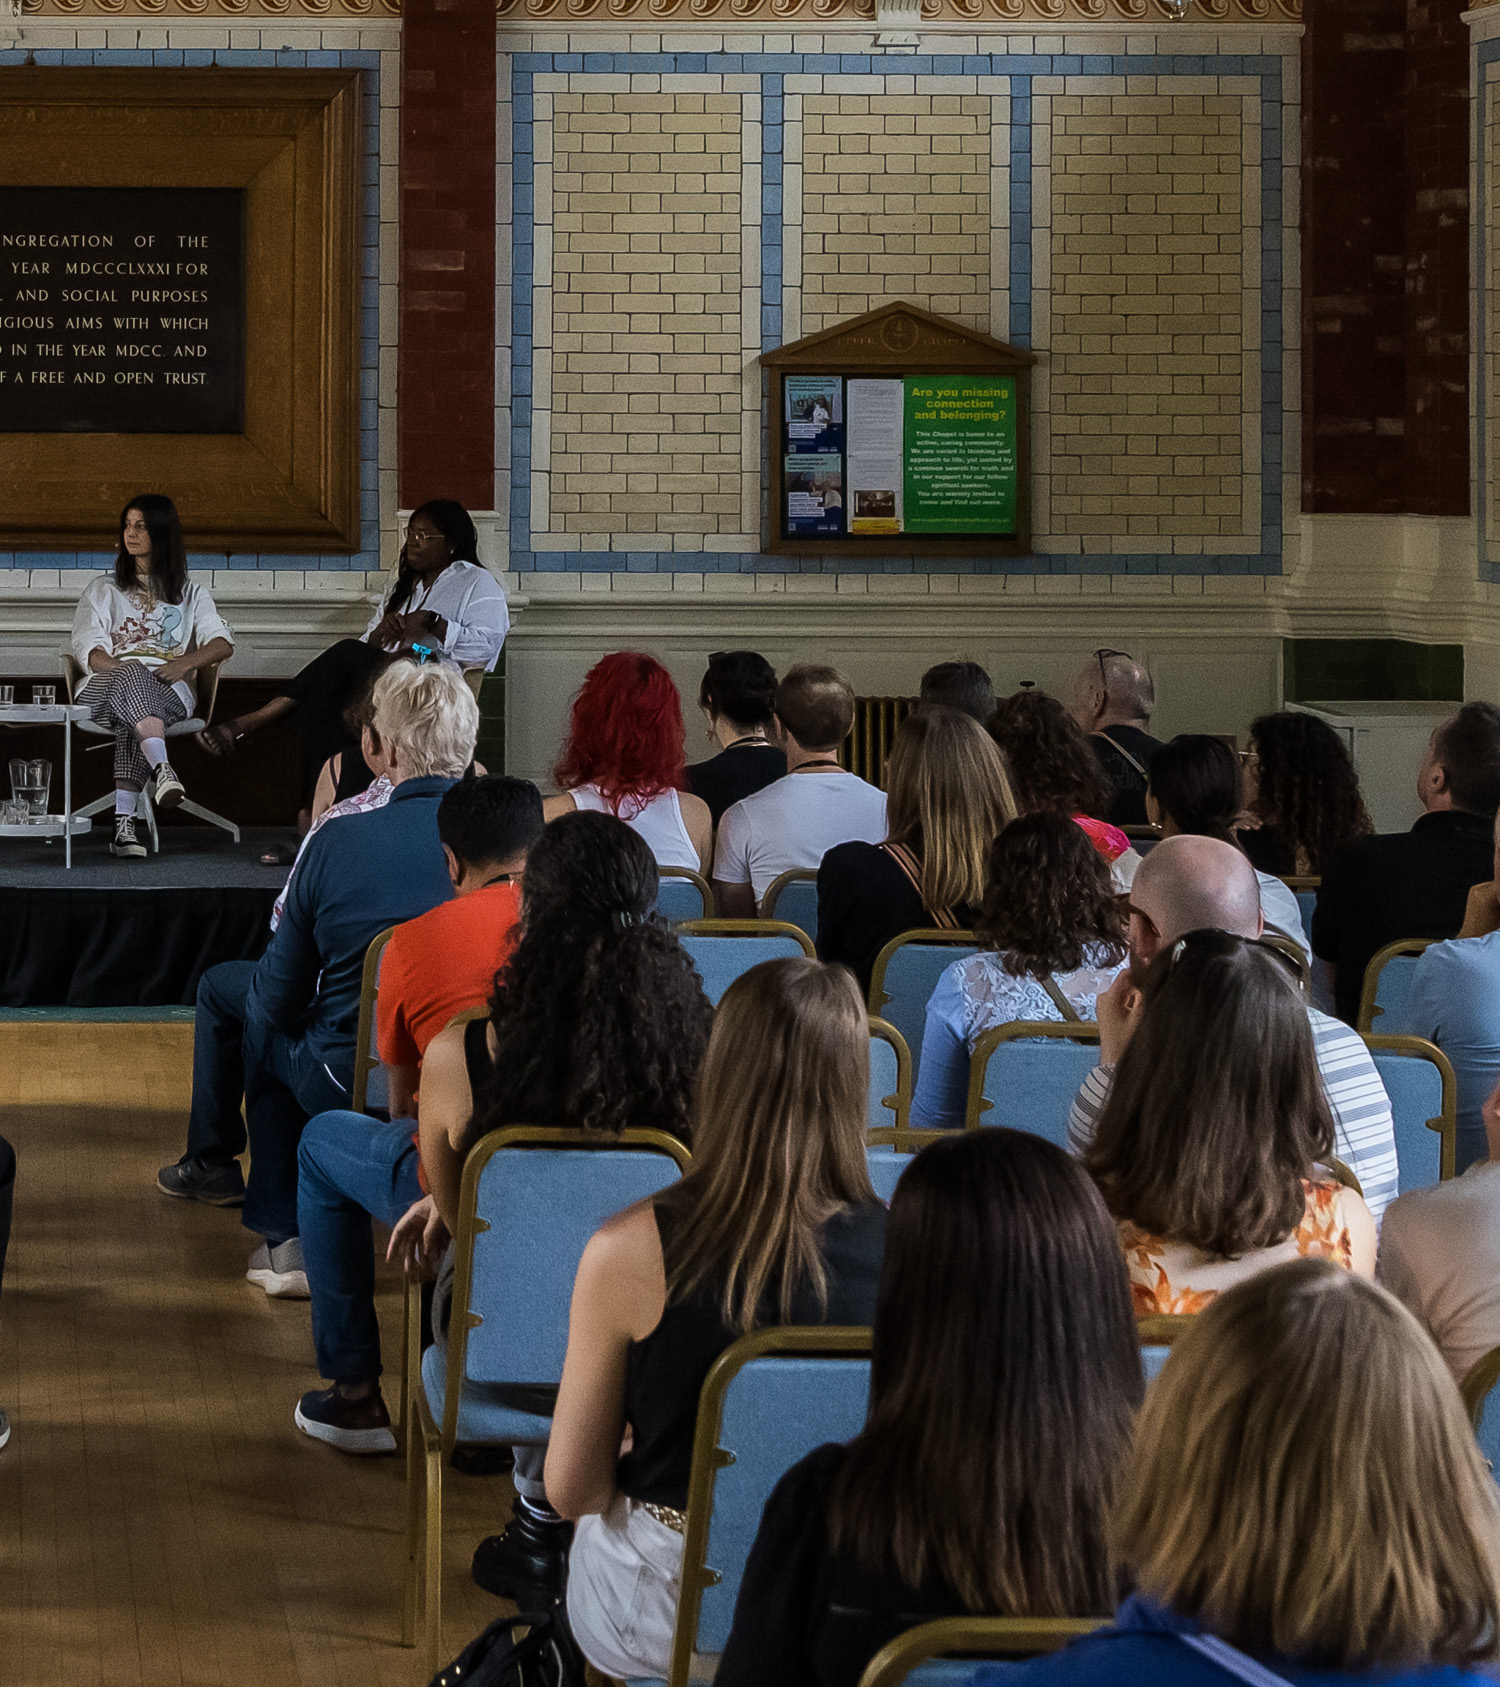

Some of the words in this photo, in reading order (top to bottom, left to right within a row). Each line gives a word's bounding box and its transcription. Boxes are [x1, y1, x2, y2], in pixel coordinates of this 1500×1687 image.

[134, 235, 155, 247] OF
[177, 235, 207, 247] THE
[11, 261, 49, 274] YEAR
[65, 262, 169, 275] MDCCCLXXXI
[176, 263, 207, 275] FOR
[15, 289, 48, 301] AND
[62, 289, 117, 302] SOCIAL
[131, 290, 207, 302] PURPOSES
[65, 316, 102, 329] AIMS
[113, 317, 148, 329] WITH
[159, 317, 208, 329] WHICH
[11, 343, 26, 355] IN
[36, 343, 63, 356] THE
[72, 344, 105, 356] YEAR
[173, 344, 206, 357] AND
[14, 372, 23, 383] A
[31, 371, 64, 383] FREE
[73, 371, 105, 383] AND
[114, 372, 153, 384] OPEN
[912, 388, 933, 396] Are
[936, 389, 958, 398] you
[962, 388, 1008, 399] missing
[926, 399, 993, 408] connection
[914, 410, 936, 419] and
[939, 410, 1005, 421] belonging?
